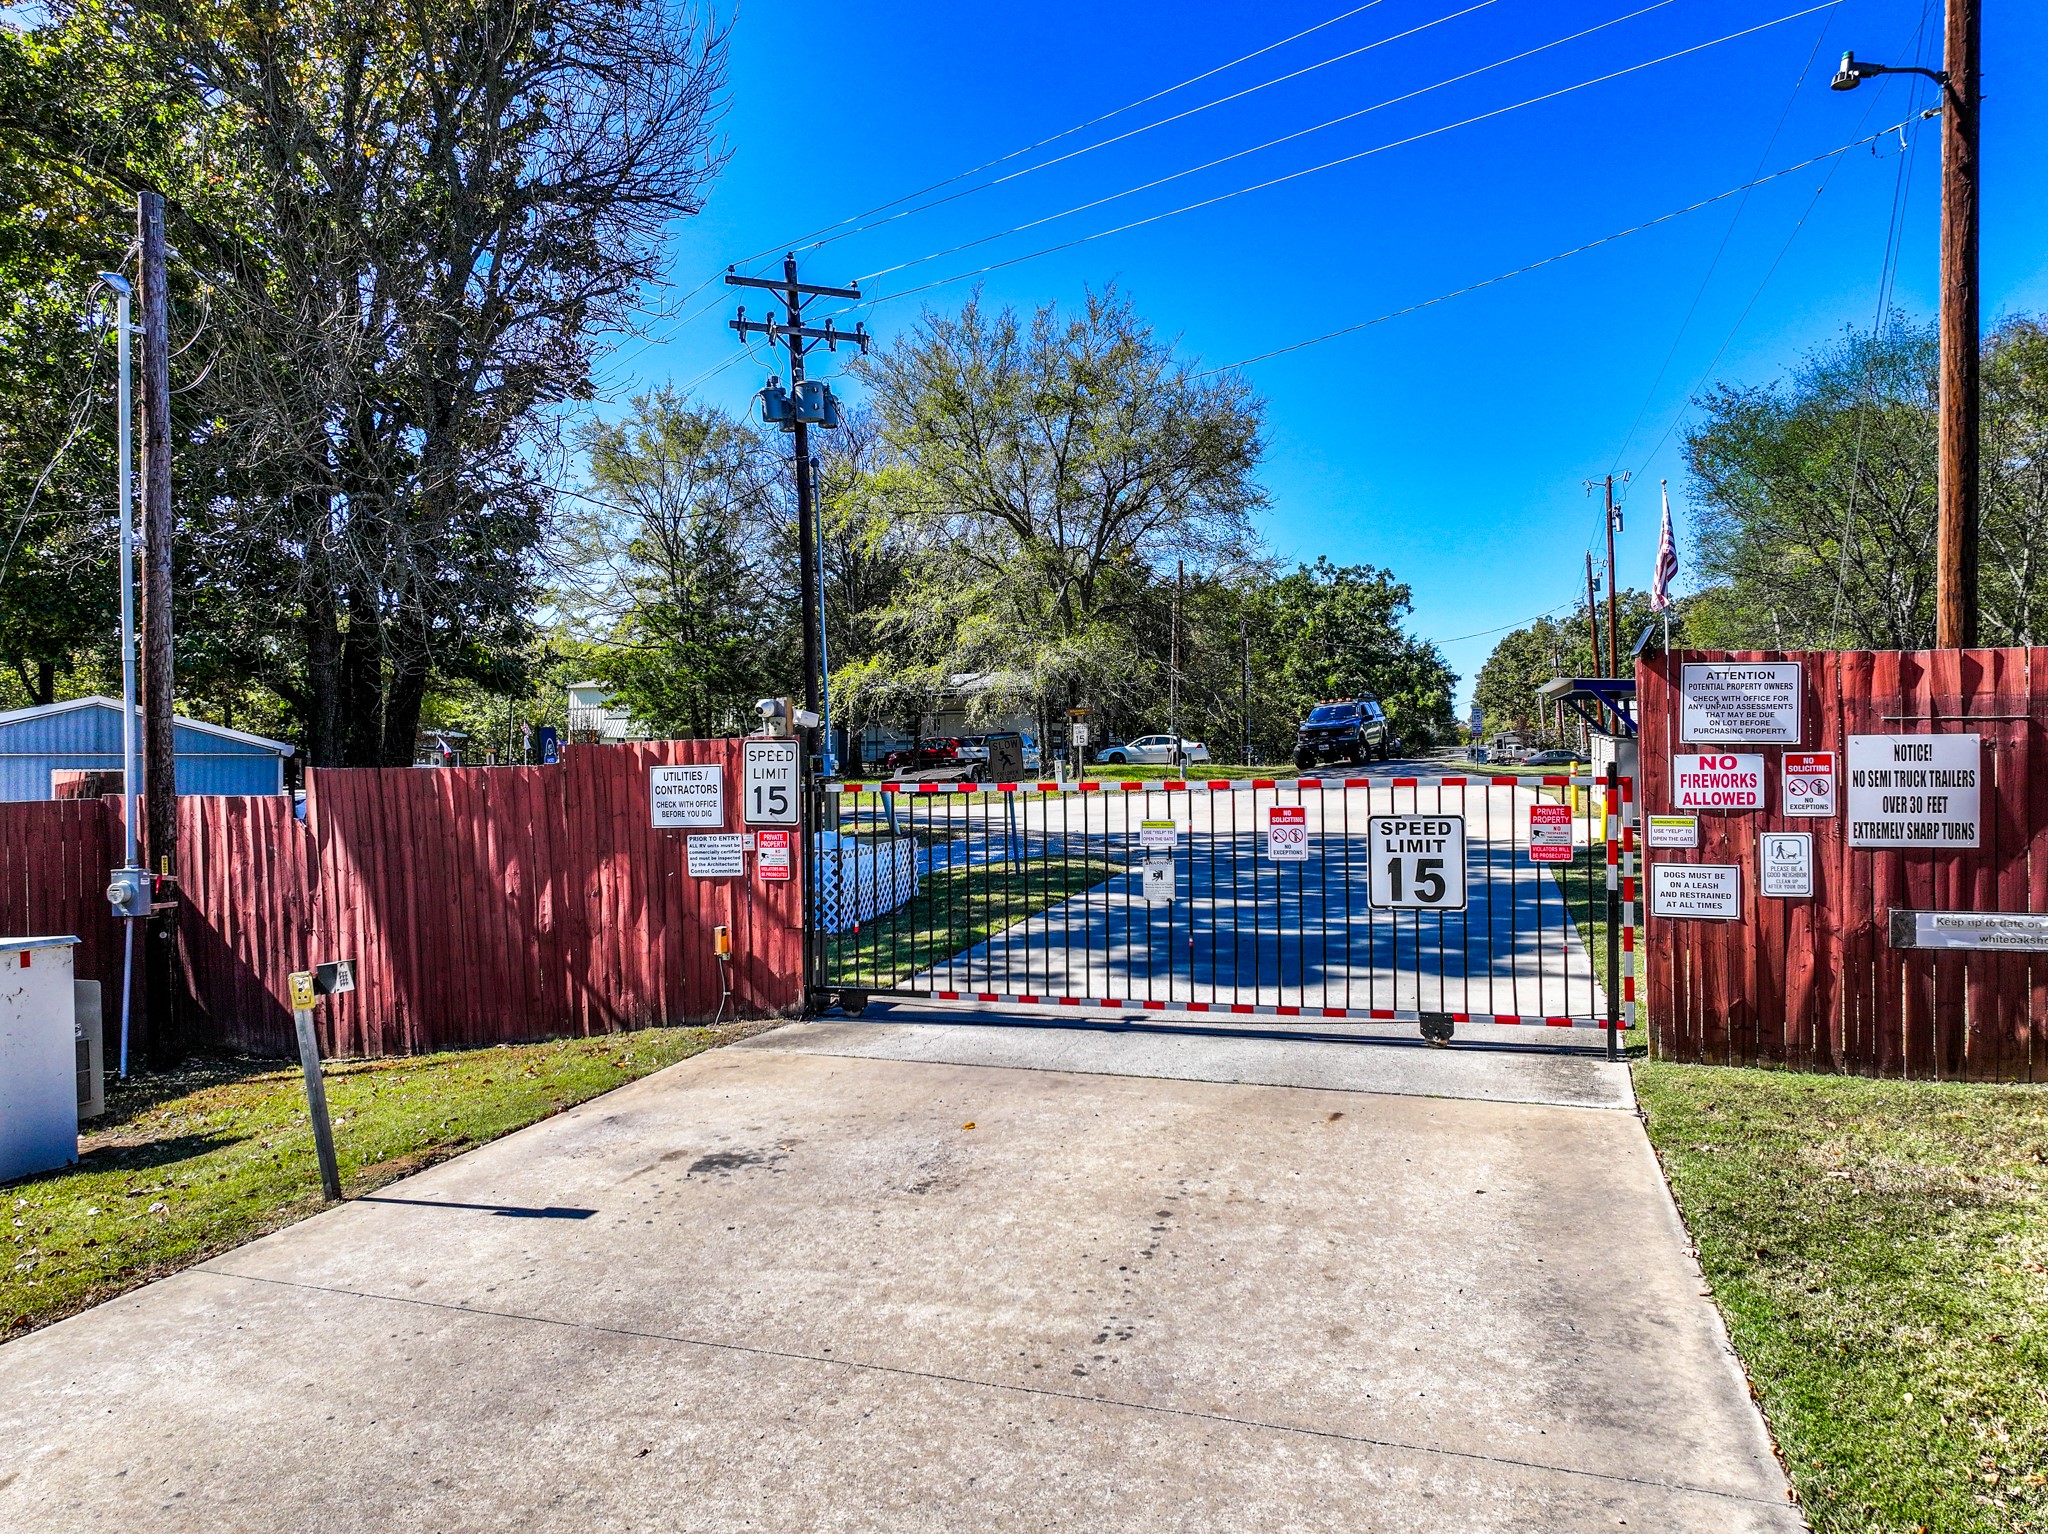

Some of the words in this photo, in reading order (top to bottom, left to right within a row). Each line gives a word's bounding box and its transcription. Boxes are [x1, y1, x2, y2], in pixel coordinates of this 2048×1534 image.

[1706, 672, 1775, 680] ATTENTION
[992, 740, 1018, 750] SLOW
[1076, 735, 1085, 743] 15
[749, 750, 794, 761] SPEED
[1894, 744, 1932, 762] NOTICE!
[1699, 756, 1737, 770] NO
[664, 771, 702, 781] UTILITIES
[705, 771, 708, 780] /
[754, 768, 788, 779] LIMIT
[1853, 770, 1865, 787] NO
[1868, 770, 1891, 787] SEMI
[1894, 770, 1927, 787] TRUCK
[1929, 770, 1975, 787] TRAILERS
[1681, 773, 1757, 788] FIREWORKS
[655, 784, 718, 795] CONTRACTORS
[754, 786, 788, 815] 15
[1683, 792, 1756, 805] ALLOWED
[1883, 796, 1907, 813] OVER
[1910, 796, 1922, 813] 30
[1927, 796, 1948, 813] FEET
[1381, 822, 1451, 836] SPEED
[1853, 822, 1904, 839] EXTREMELY
[1907, 822, 1939, 840] SHARP
[1942, 822, 1974, 840] TURNS
[1386, 839, 1446, 852] LIMIT
[1388, 858, 1446, 903] 15
[1936, 918, 1964, 928] Keep
[2000, 920, 2024, 928] date
